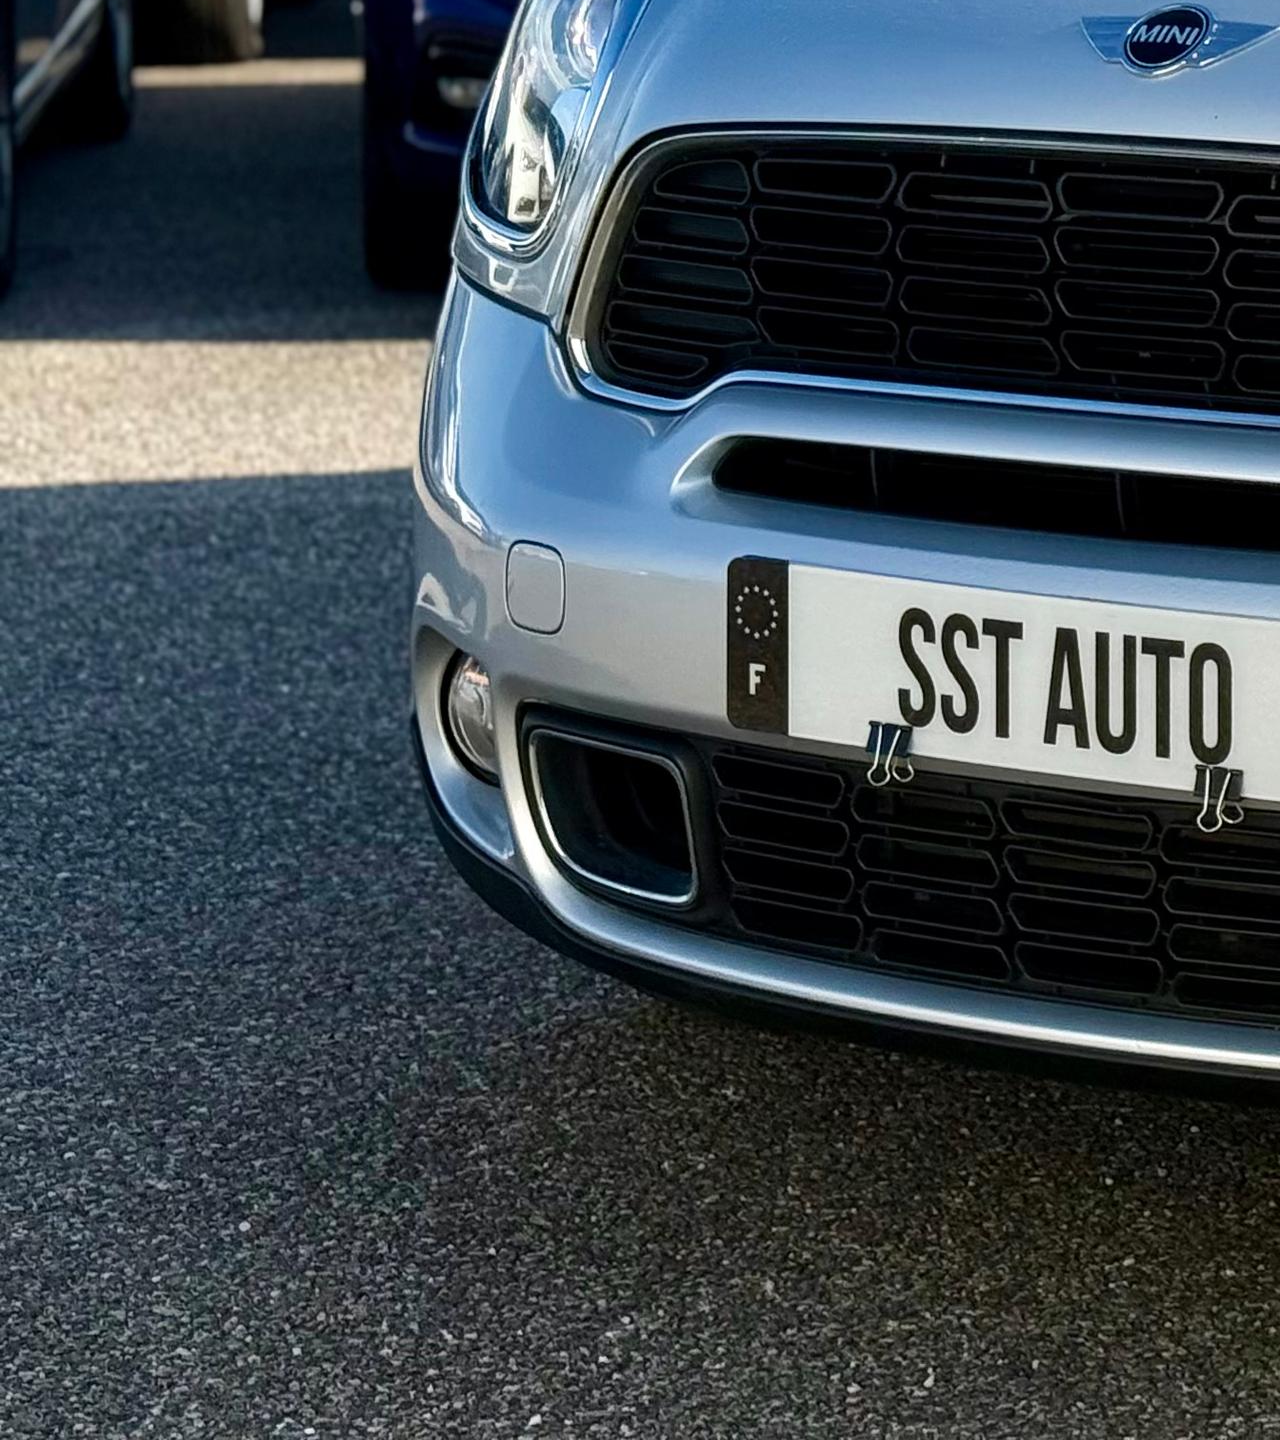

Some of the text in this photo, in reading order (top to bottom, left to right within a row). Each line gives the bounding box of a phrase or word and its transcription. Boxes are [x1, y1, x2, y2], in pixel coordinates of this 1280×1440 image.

[1132, 24, 1200, 45] MINI
[748, 662, 767, 696] F
[897, 606, 1235, 766] SST AUTO
